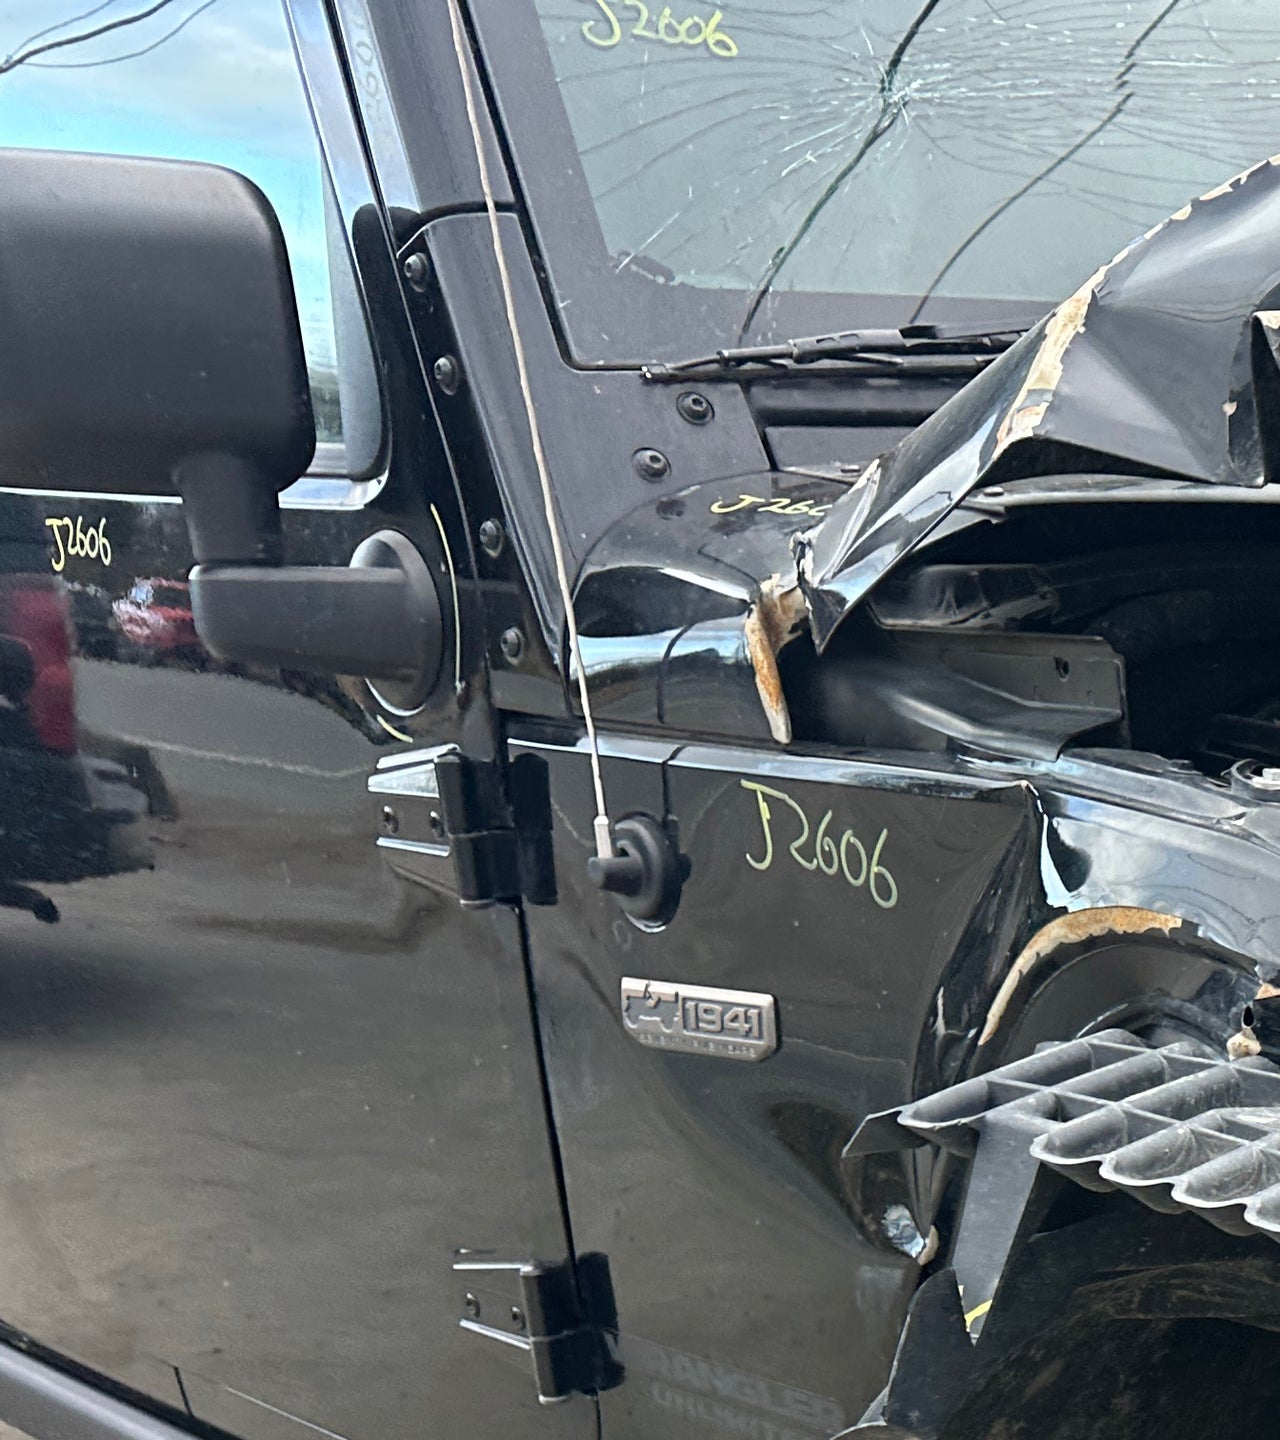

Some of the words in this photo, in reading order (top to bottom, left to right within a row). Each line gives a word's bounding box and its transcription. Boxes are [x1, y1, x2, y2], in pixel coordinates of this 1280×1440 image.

[582, 0, 739, 57] J2606
[45, 515, 112, 572] J2606
[740, 778, 898, 909] J2606
[684, 1001, 762, 1038] 1941
